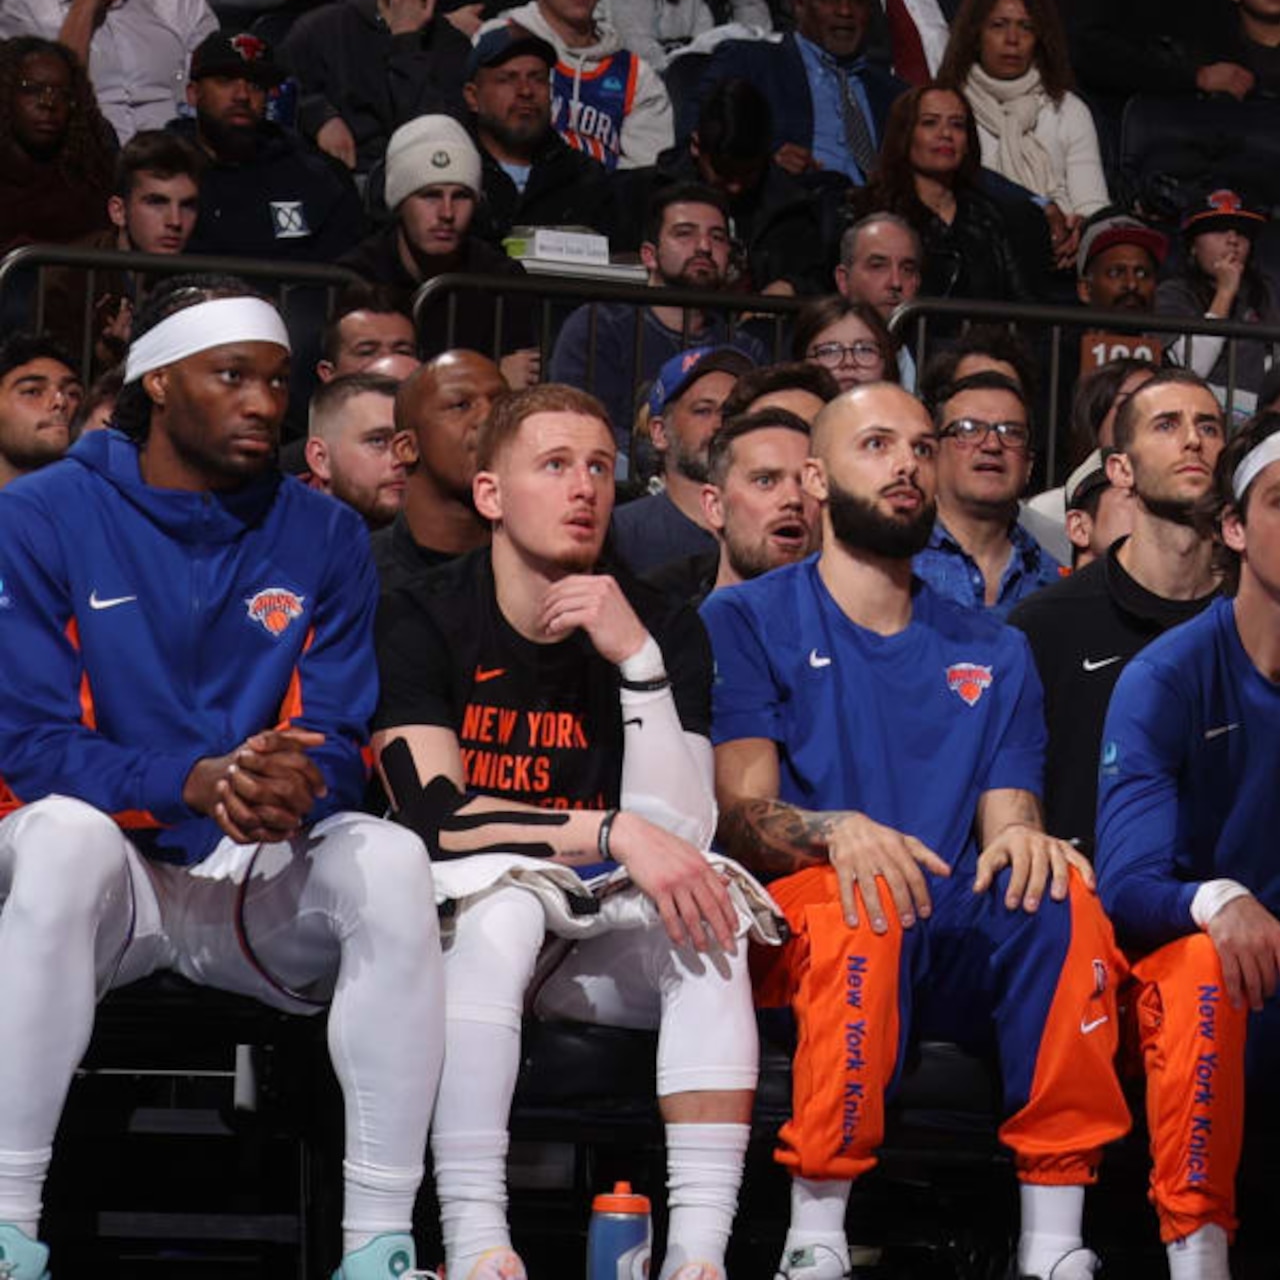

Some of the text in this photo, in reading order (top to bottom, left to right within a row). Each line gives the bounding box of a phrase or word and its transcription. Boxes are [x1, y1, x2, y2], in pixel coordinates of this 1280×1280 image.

[461, 703, 588, 749] NEW YORK
[459, 746, 551, 793] KNICKS
[846, 955, 868, 1010] New
[1197, 984, 1220, 1041] New
[845, 1019, 867, 1071] York
[1193, 1052, 1219, 1106] York
